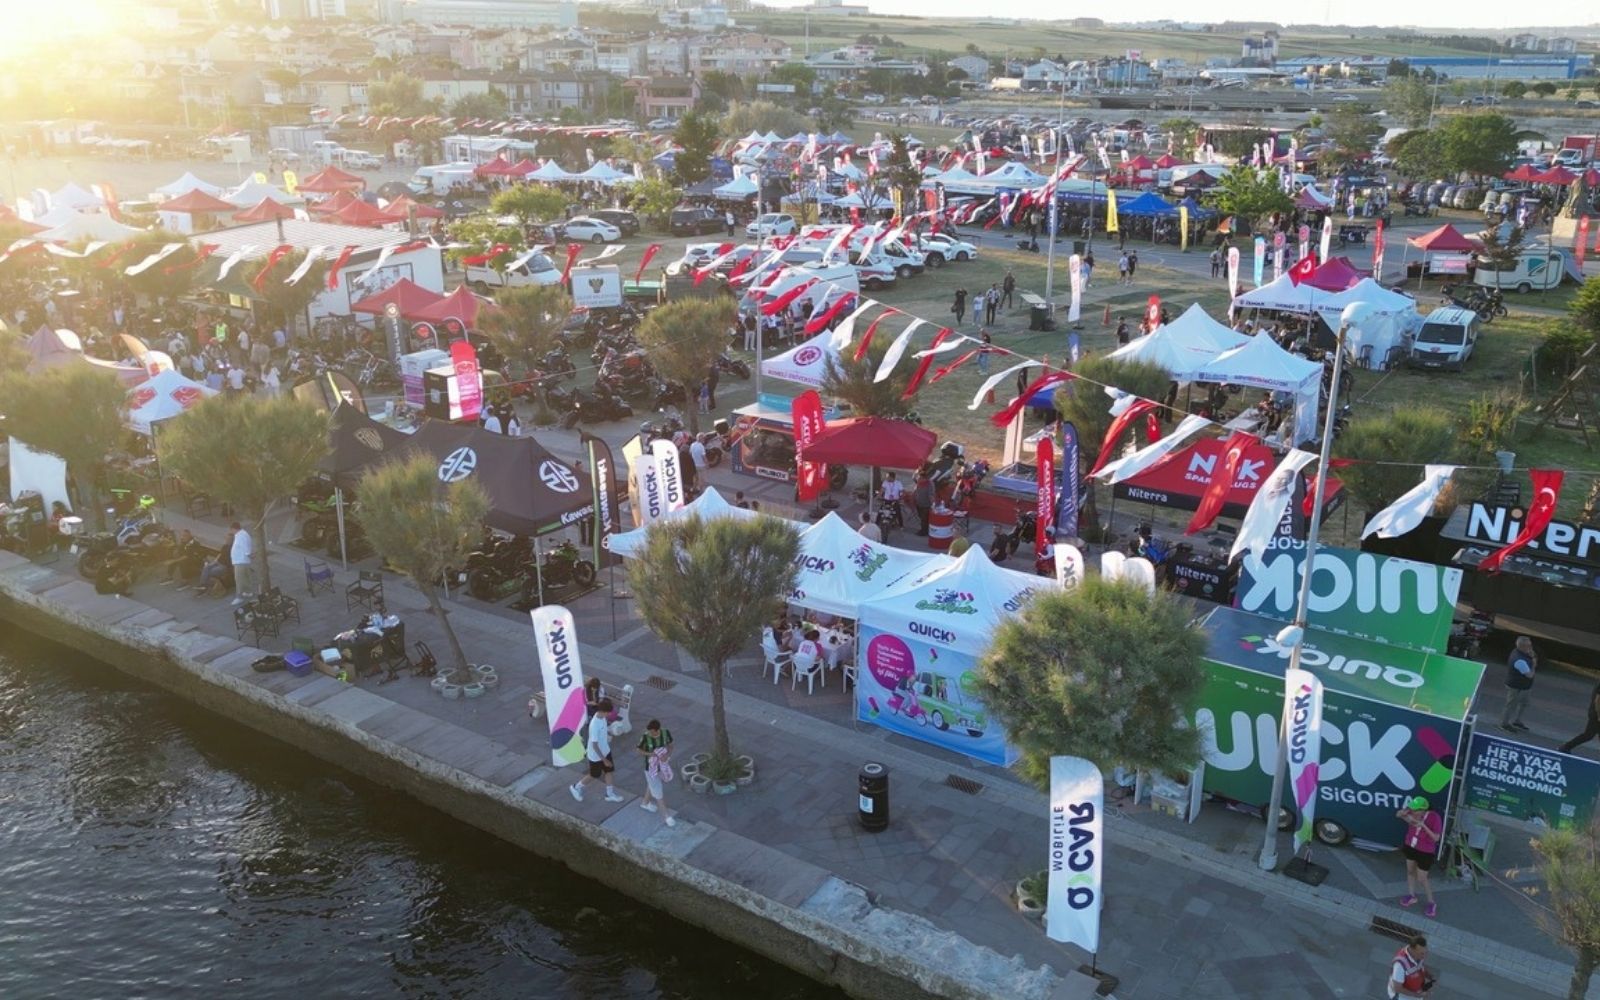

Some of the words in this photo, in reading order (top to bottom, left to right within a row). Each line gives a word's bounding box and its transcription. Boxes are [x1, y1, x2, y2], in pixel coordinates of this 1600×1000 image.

[1188, 451, 1265, 481] NK
[1184, 472, 1211, 484] SPAR
[1128, 487, 1168, 503] Niterra
[560, 503, 594, 525] Kawas
[1468, 502, 1600, 558] Nier
[793, 553, 829, 572] UICK
[1175, 565, 1219, 584] Niterra
[909, 621, 949, 642] QUICK
[1256, 637, 1425, 688] QUICK
[1477, 754, 1509, 772] HER
[1512, 764, 1567, 787] ARACA
[1487, 745, 1519, 763] HER
[1524, 754, 1562, 774] YAŞA
